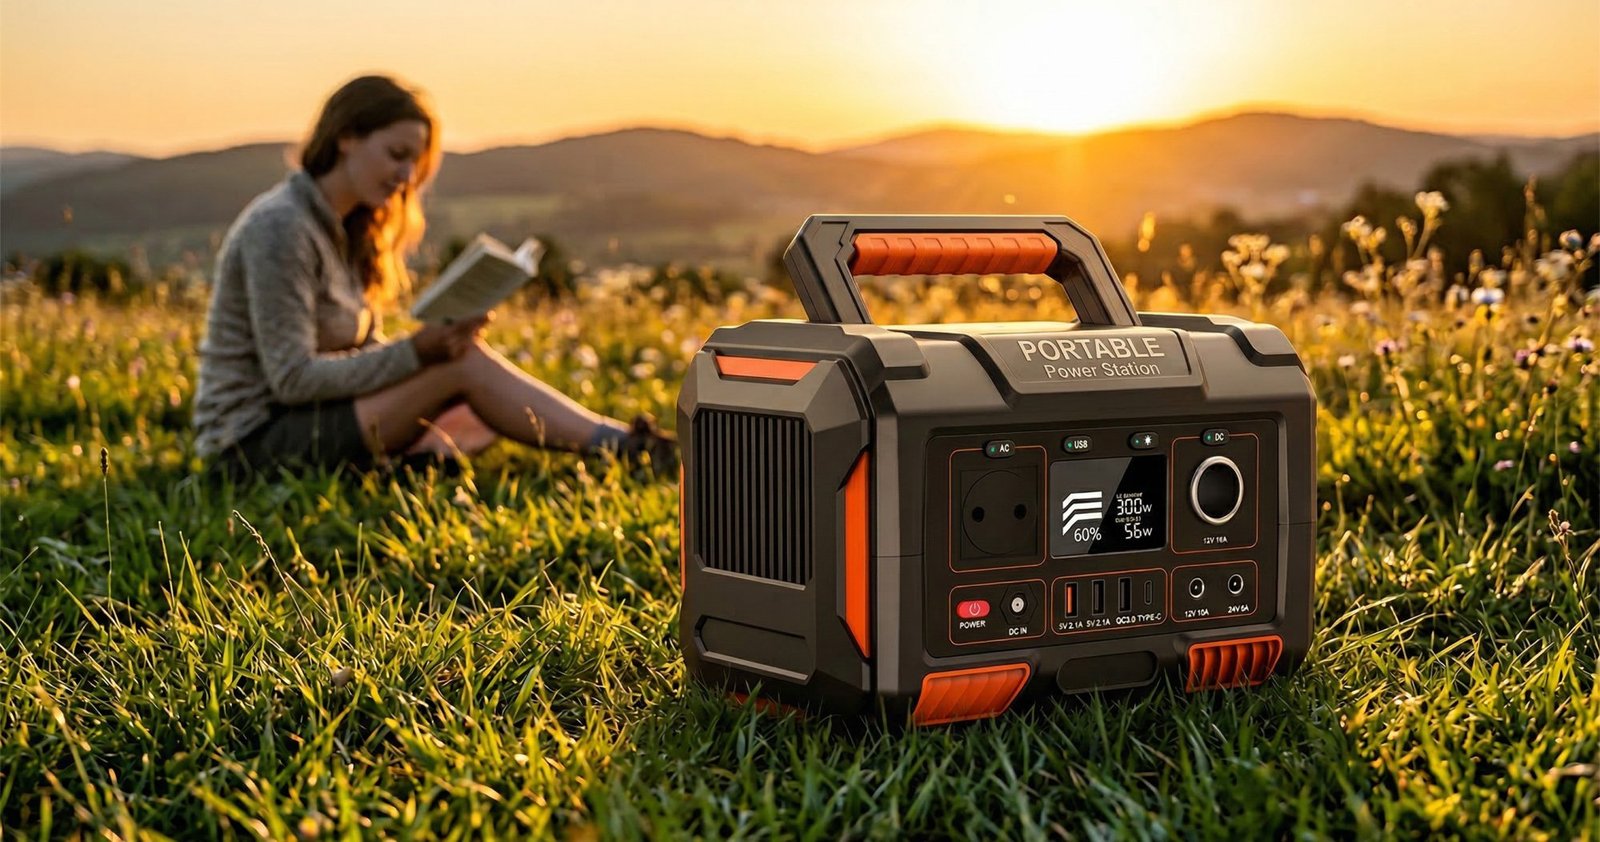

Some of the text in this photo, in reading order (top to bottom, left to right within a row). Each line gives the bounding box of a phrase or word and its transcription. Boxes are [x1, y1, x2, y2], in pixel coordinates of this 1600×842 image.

[1018, 337, 1165, 362] PORTABLE
[1044, 362, 1161, 379] Power Station
[1214, 432, 1225, 442] DC
[999, 443, 1010, 453] AC
[1074, 440, 1088, 449] USB
[1074, 526, 1102, 542] 60%
[1227, 606, 1240, 614] 24V
[959, 620, 986, 629] POWER
[1008, 626, 1028, 636] DC IN
